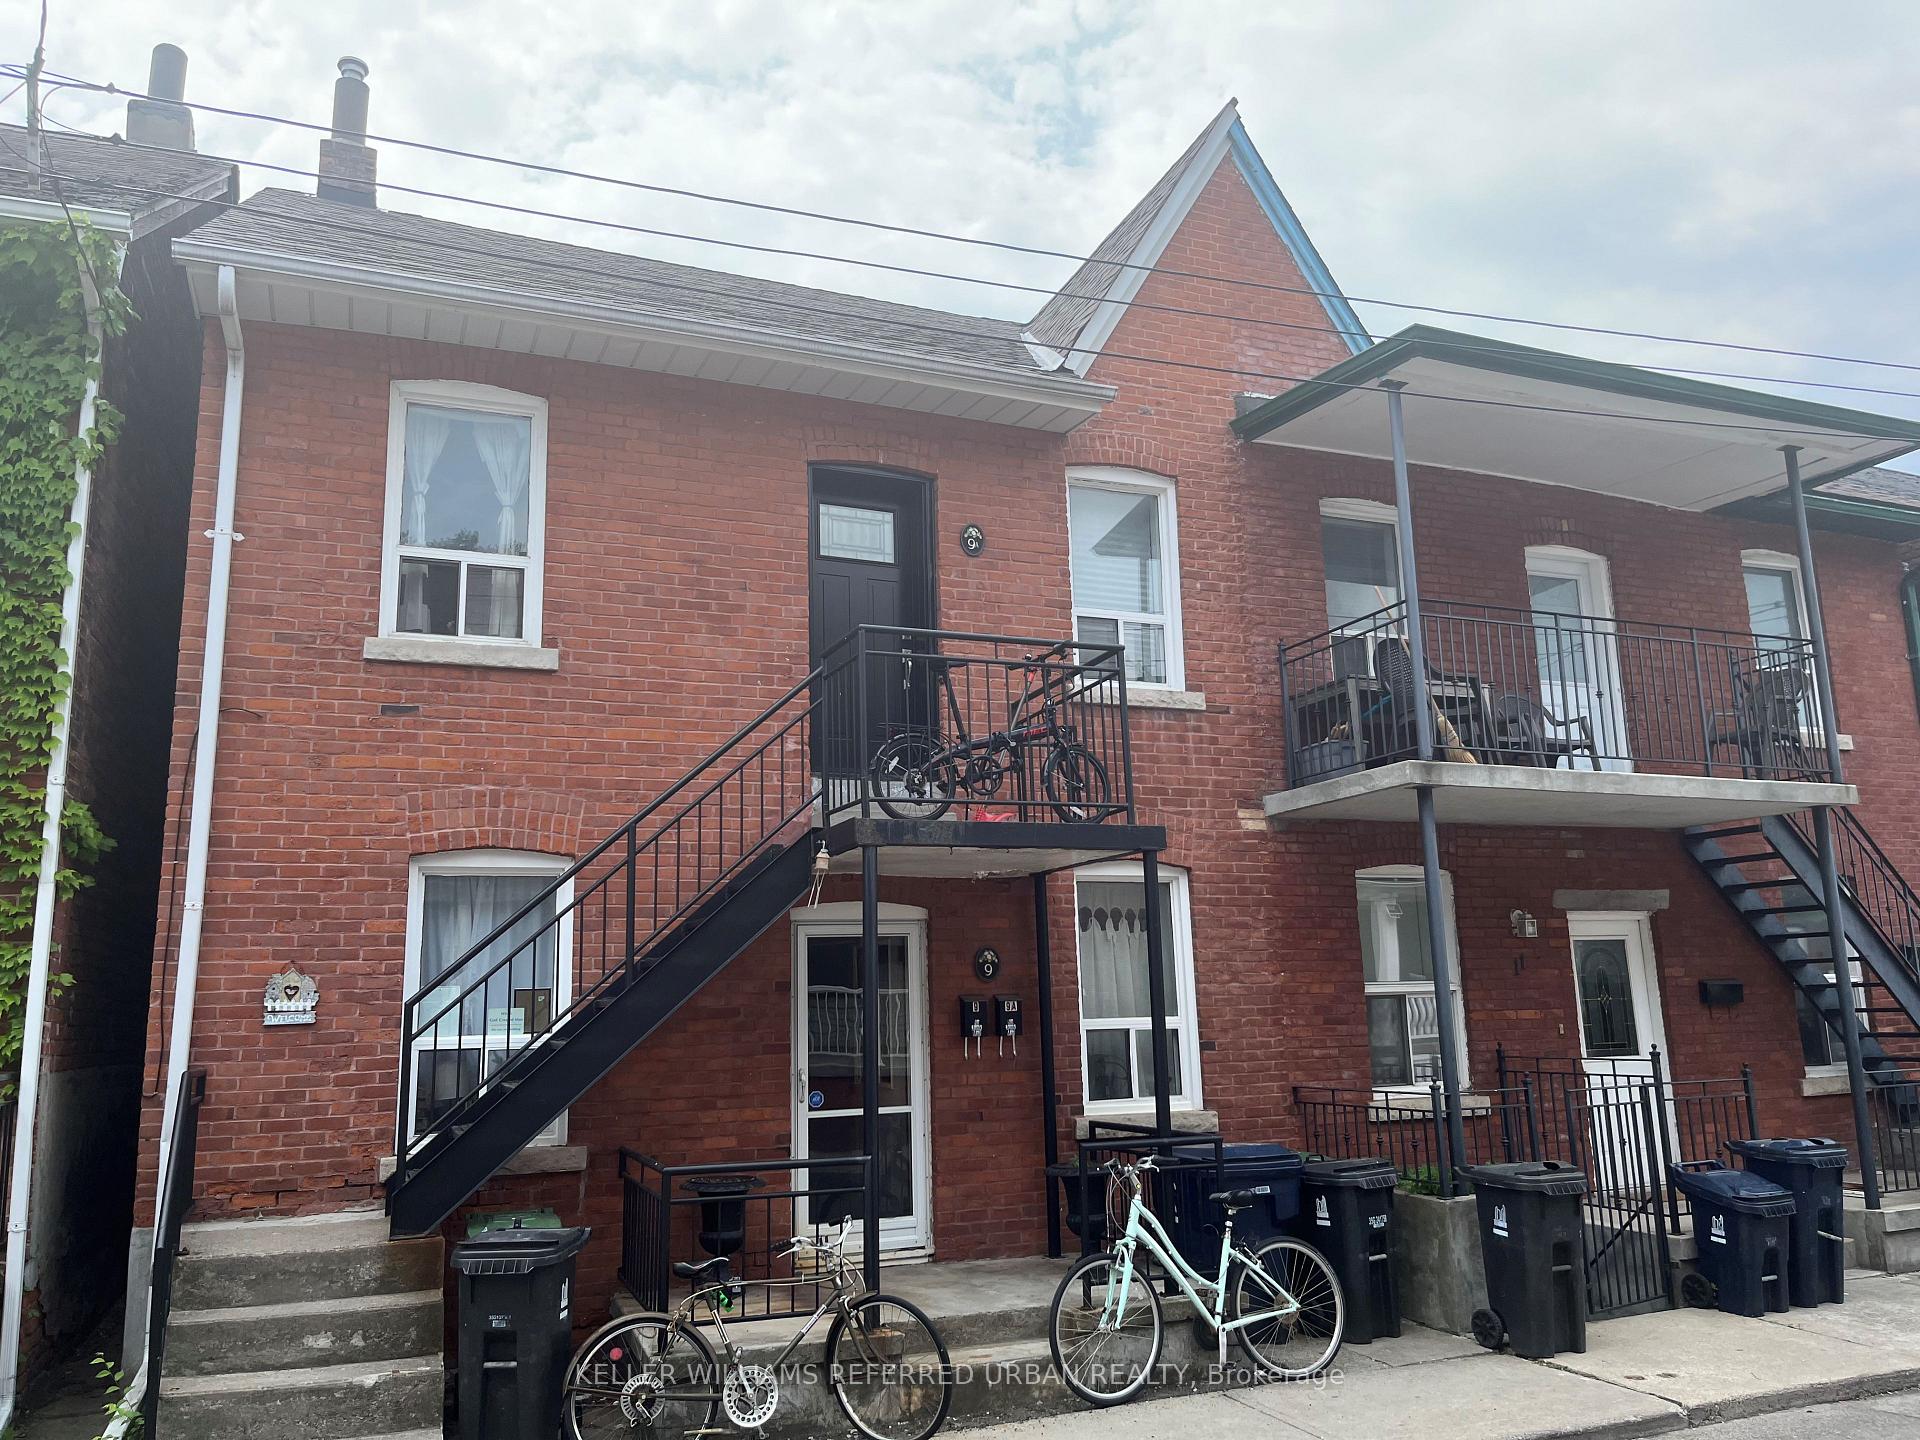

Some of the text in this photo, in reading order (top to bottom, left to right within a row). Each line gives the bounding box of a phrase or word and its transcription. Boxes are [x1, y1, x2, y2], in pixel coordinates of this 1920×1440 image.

[967, 538, 976, 549] 9
[984, 963, 992, 976] 9
[1005, 1001, 1017, 1011] 9A
